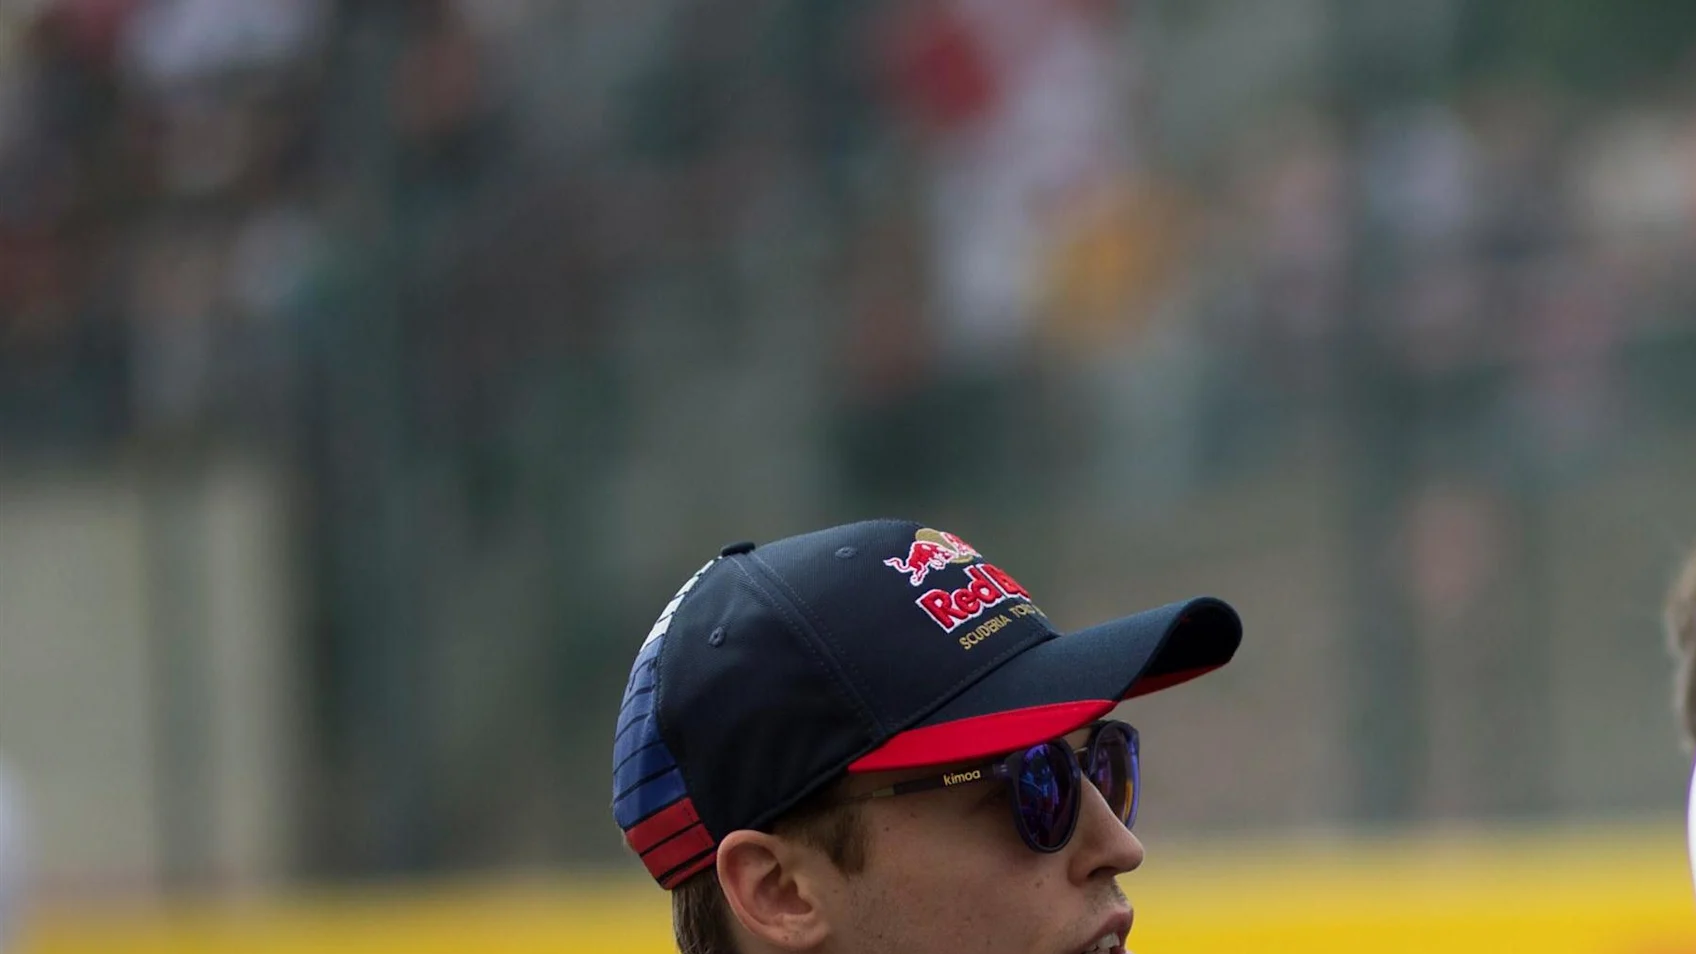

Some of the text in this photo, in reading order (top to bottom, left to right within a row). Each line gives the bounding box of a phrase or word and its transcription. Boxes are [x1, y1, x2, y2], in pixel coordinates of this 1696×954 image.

[915, 565, 1005, 634] Red
[959, 614, 1013, 650] SCUDERIA
[943, 770, 981, 786] kimoa
